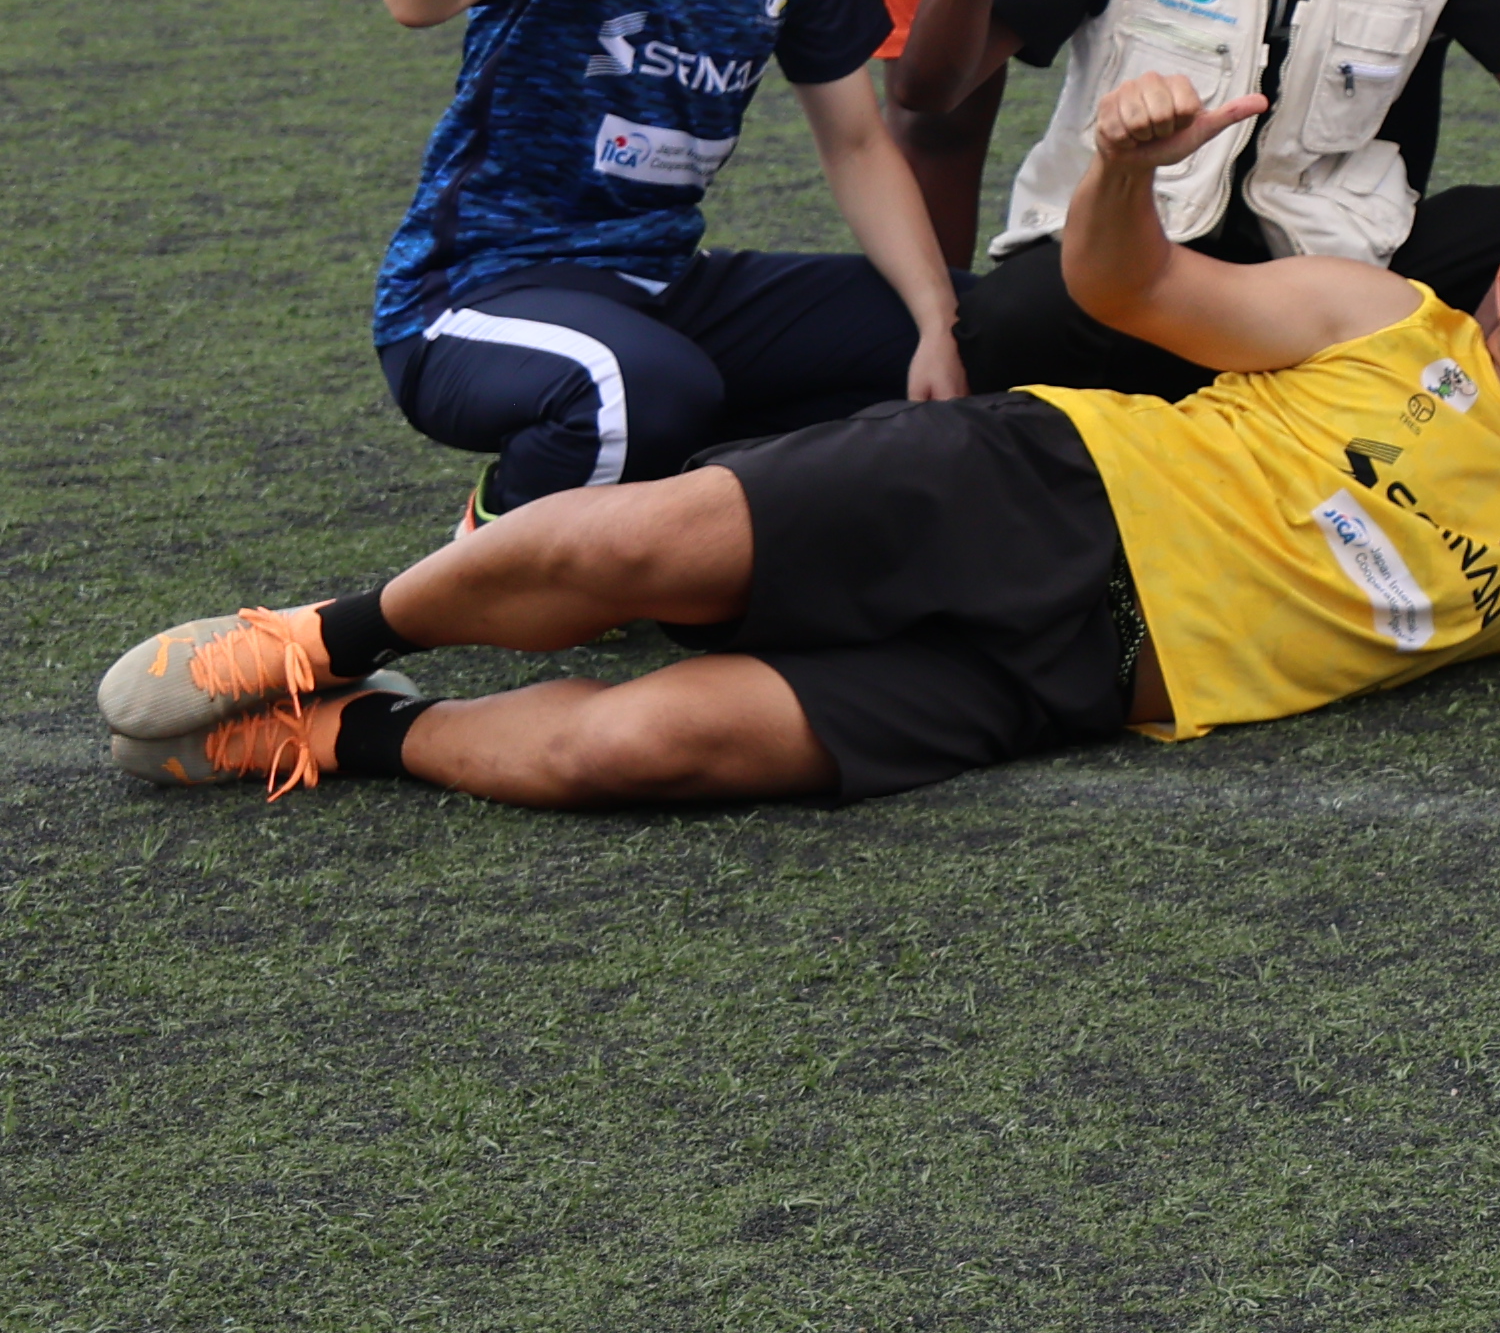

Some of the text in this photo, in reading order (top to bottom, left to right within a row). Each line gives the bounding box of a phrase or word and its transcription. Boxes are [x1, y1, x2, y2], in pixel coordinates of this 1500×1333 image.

[600, 137, 638, 169] JICA
[1322, 507, 1359, 546] JICA
[1369, 546, 1393, 580] Japan
